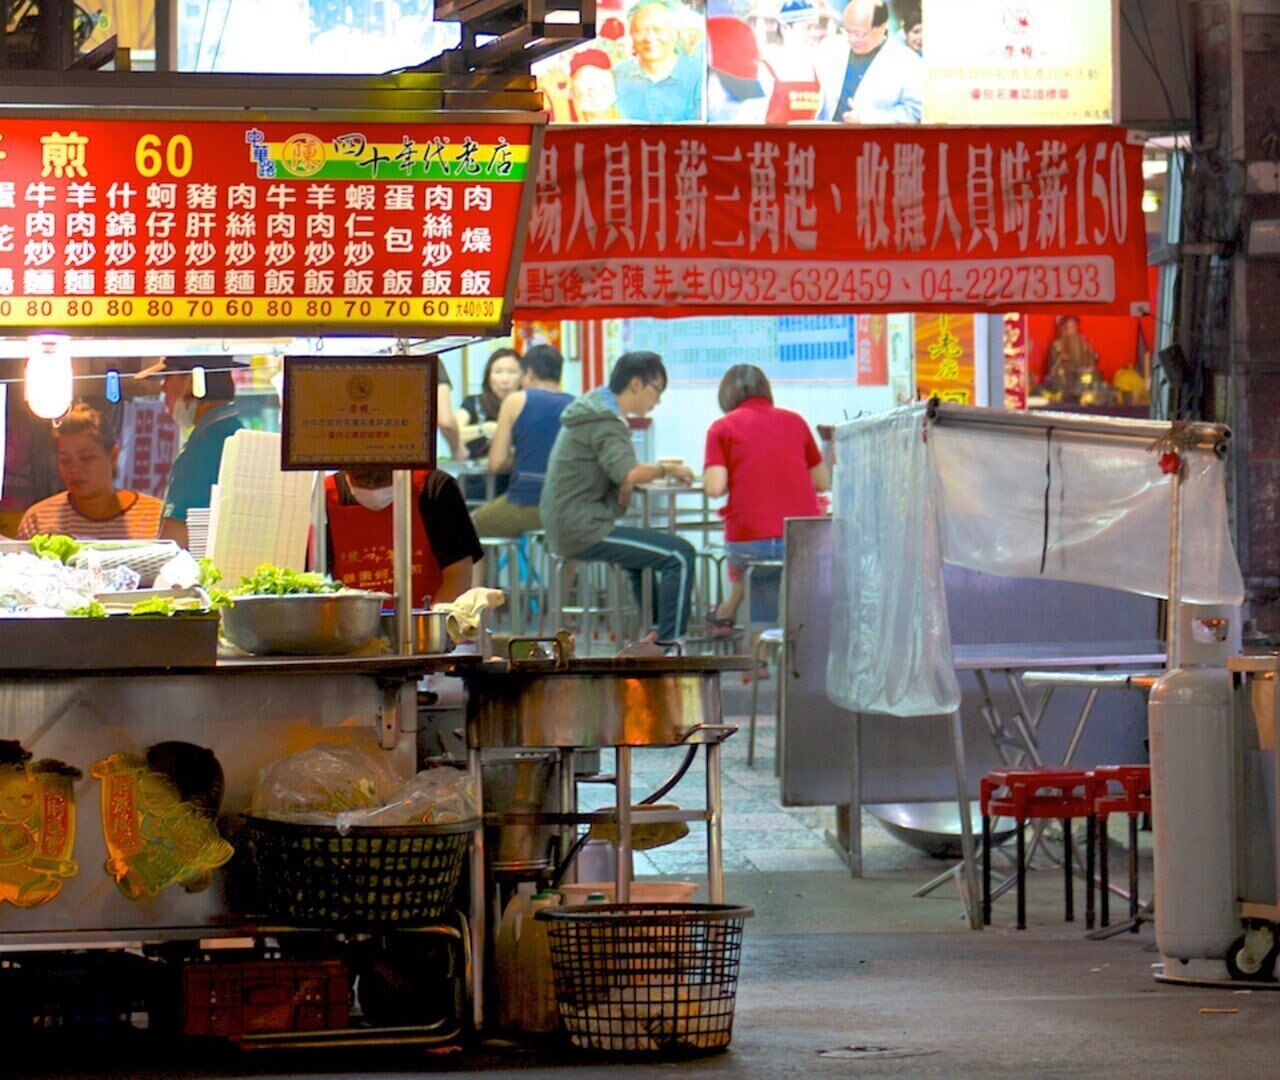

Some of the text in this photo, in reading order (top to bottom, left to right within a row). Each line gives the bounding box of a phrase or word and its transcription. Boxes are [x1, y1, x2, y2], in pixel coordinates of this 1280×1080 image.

[134, 134, 194, 178] 60
[23, 182, 56, 295] 牛肉炒麵
[64, 182, 97, 317] 羊肉炒麵 80
[104, 182, 137, 295] 什錦炒麵
[144, 183, 177, 317] 蚵仔炒麵 80
[185, 183, 218, 295] 豬肝炒麵
[224, 183, 257, 317] 肉絲炒麵 60
[264, 184, 297, 295] 牛肉炒飯
[304, 184, 336, 317] 羊肉炒飯 80
[344, 184, 376, 295] 蝦仁炒飯
[383, 184, 415, 317] 蛋包飯 70
[422, 185, 453, 295] 肉絲炒飯
[460, 185, 492, 296] 肉燥飯
